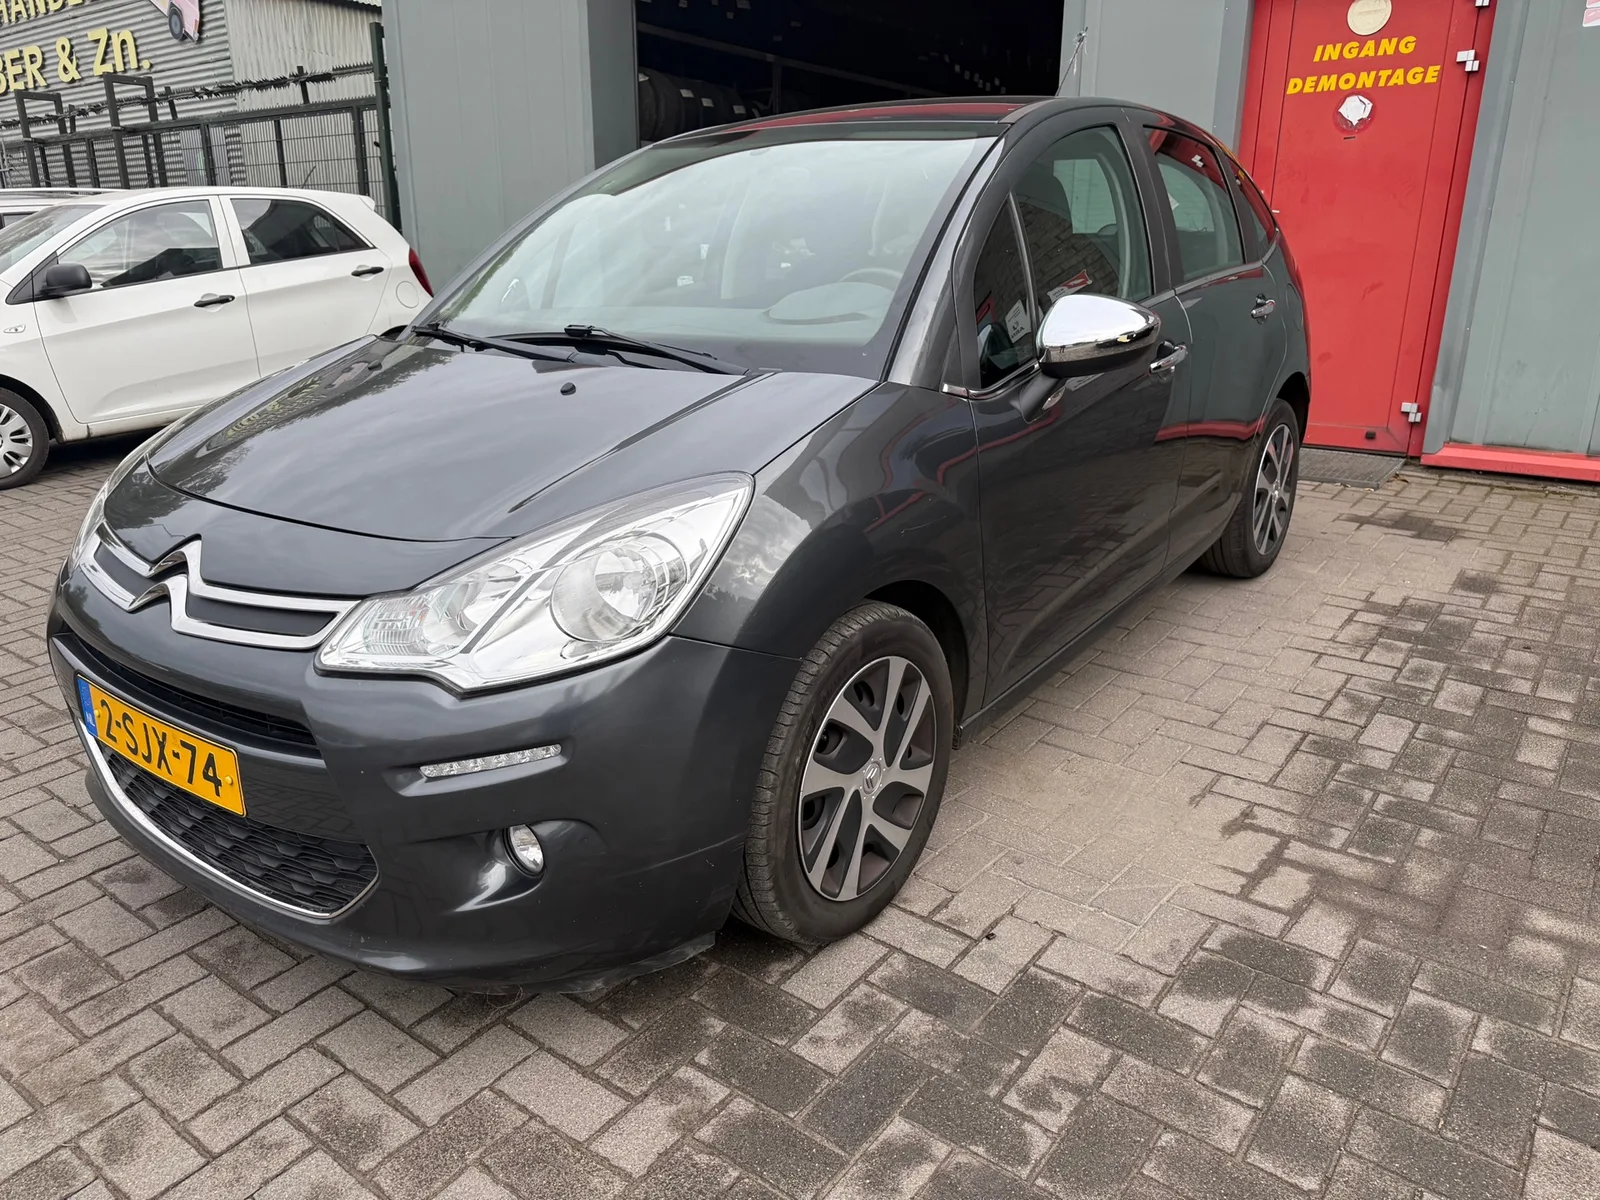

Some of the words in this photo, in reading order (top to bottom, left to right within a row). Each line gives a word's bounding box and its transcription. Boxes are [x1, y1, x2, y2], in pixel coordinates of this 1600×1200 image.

[56, 36, 82, 83] &
[87, 27, 152, 76] Zn.
[1313, 36, 1417, 63] INGANG
[1286, 65, 1441, 95] DEMONTAGE
[101, 699, 222, 797] 2-SJX-74
